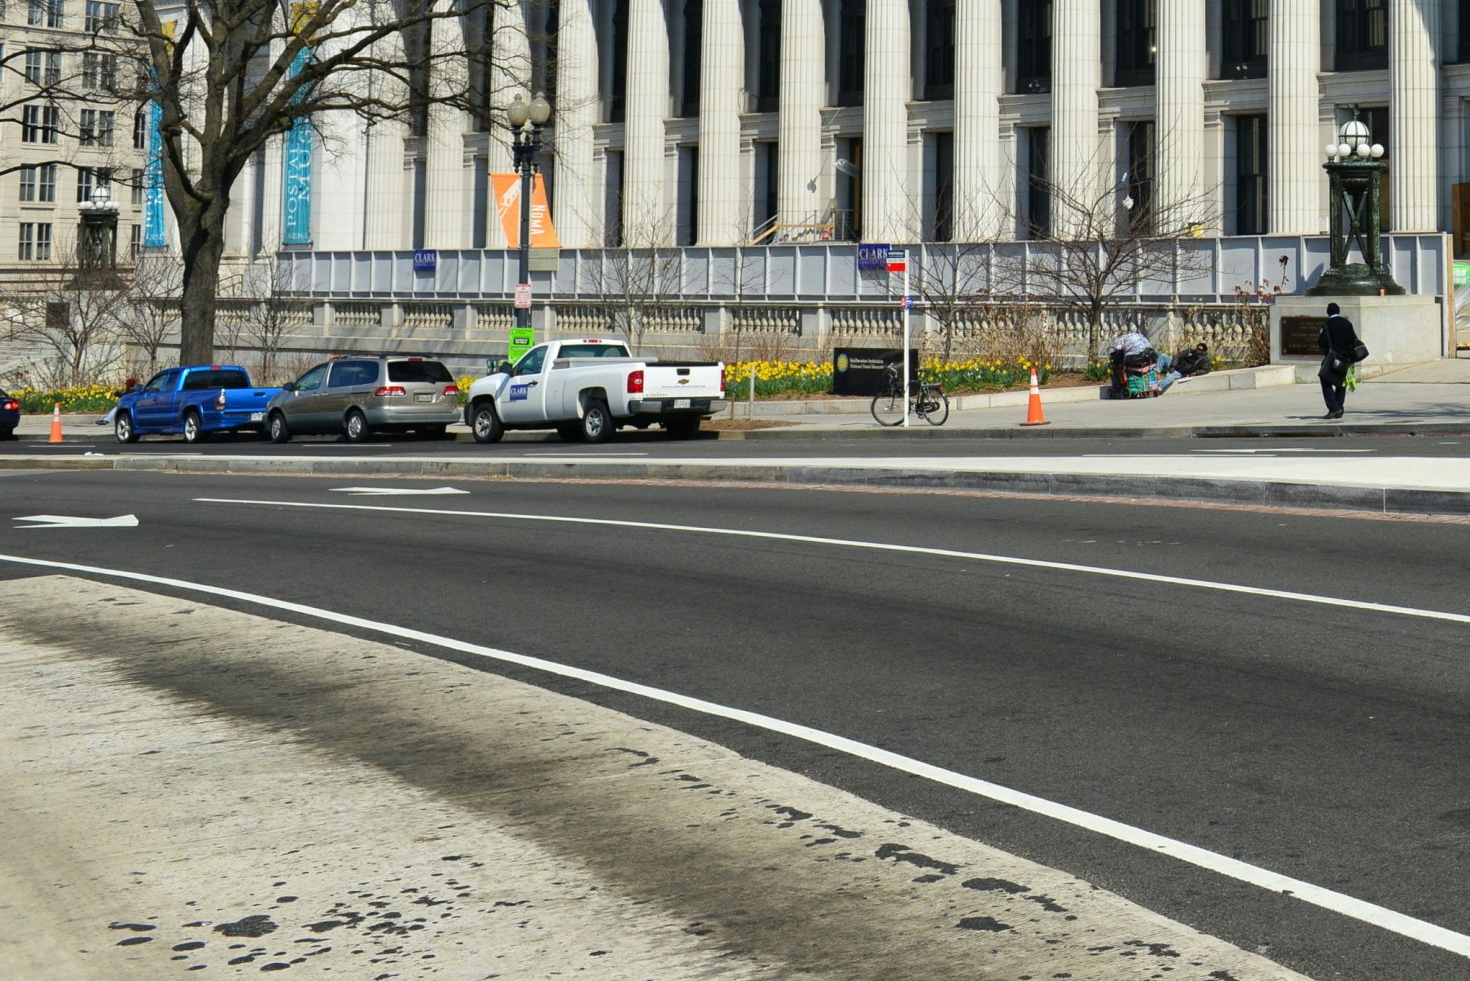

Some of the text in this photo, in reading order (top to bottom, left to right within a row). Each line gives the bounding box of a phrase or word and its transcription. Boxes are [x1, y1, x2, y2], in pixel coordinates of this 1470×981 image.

[414, 252, 436, 263] CLARK
[859, 248, 888, 260] CLARK
[510, 387, 528, 395] CLARK
